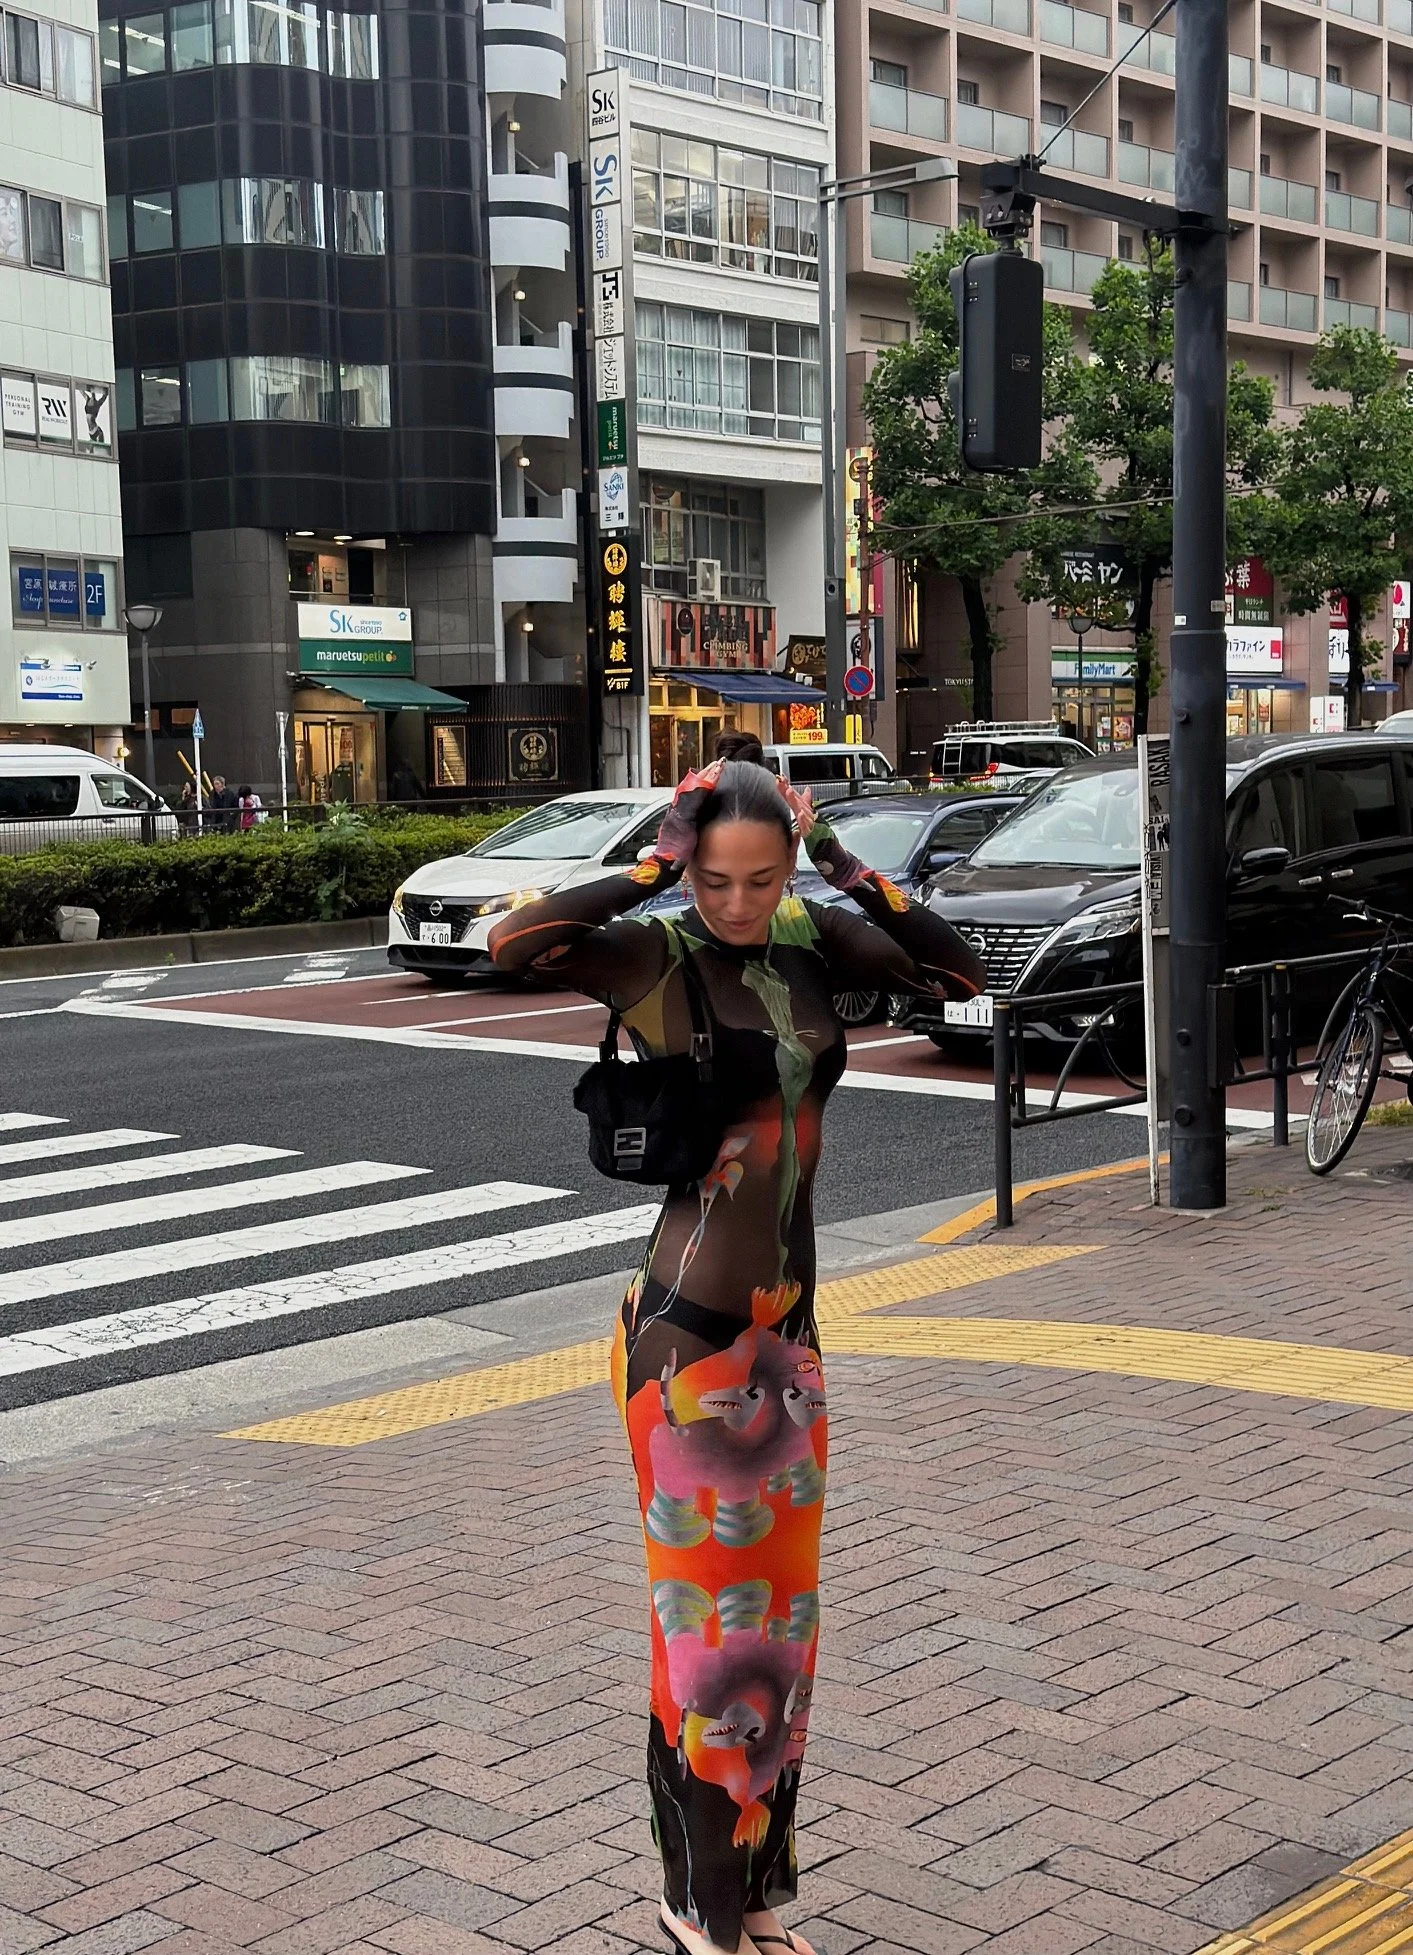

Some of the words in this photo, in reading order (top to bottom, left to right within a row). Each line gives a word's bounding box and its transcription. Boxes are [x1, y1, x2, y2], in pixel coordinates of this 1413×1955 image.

[592, 89, 615, 114] SK
[592, 113, 616, 126] 四谷ビル
[593, 154, 617, 200] SK
[602, 338, 618, 399] ジェットシステム
[604, 482, 624, 492] SANKI
[1063, 560, 1123, 584] バーミヤン
[87, 584, 103, 604] 2F
[329, 609, 353, 633] SK
[703, 641, 748, 651] CLIMBING
[717, 650, 737, 658] GYM
[1074, 662, 1116, 678] FmilyMart
[808, 731, 823, 741] 199
